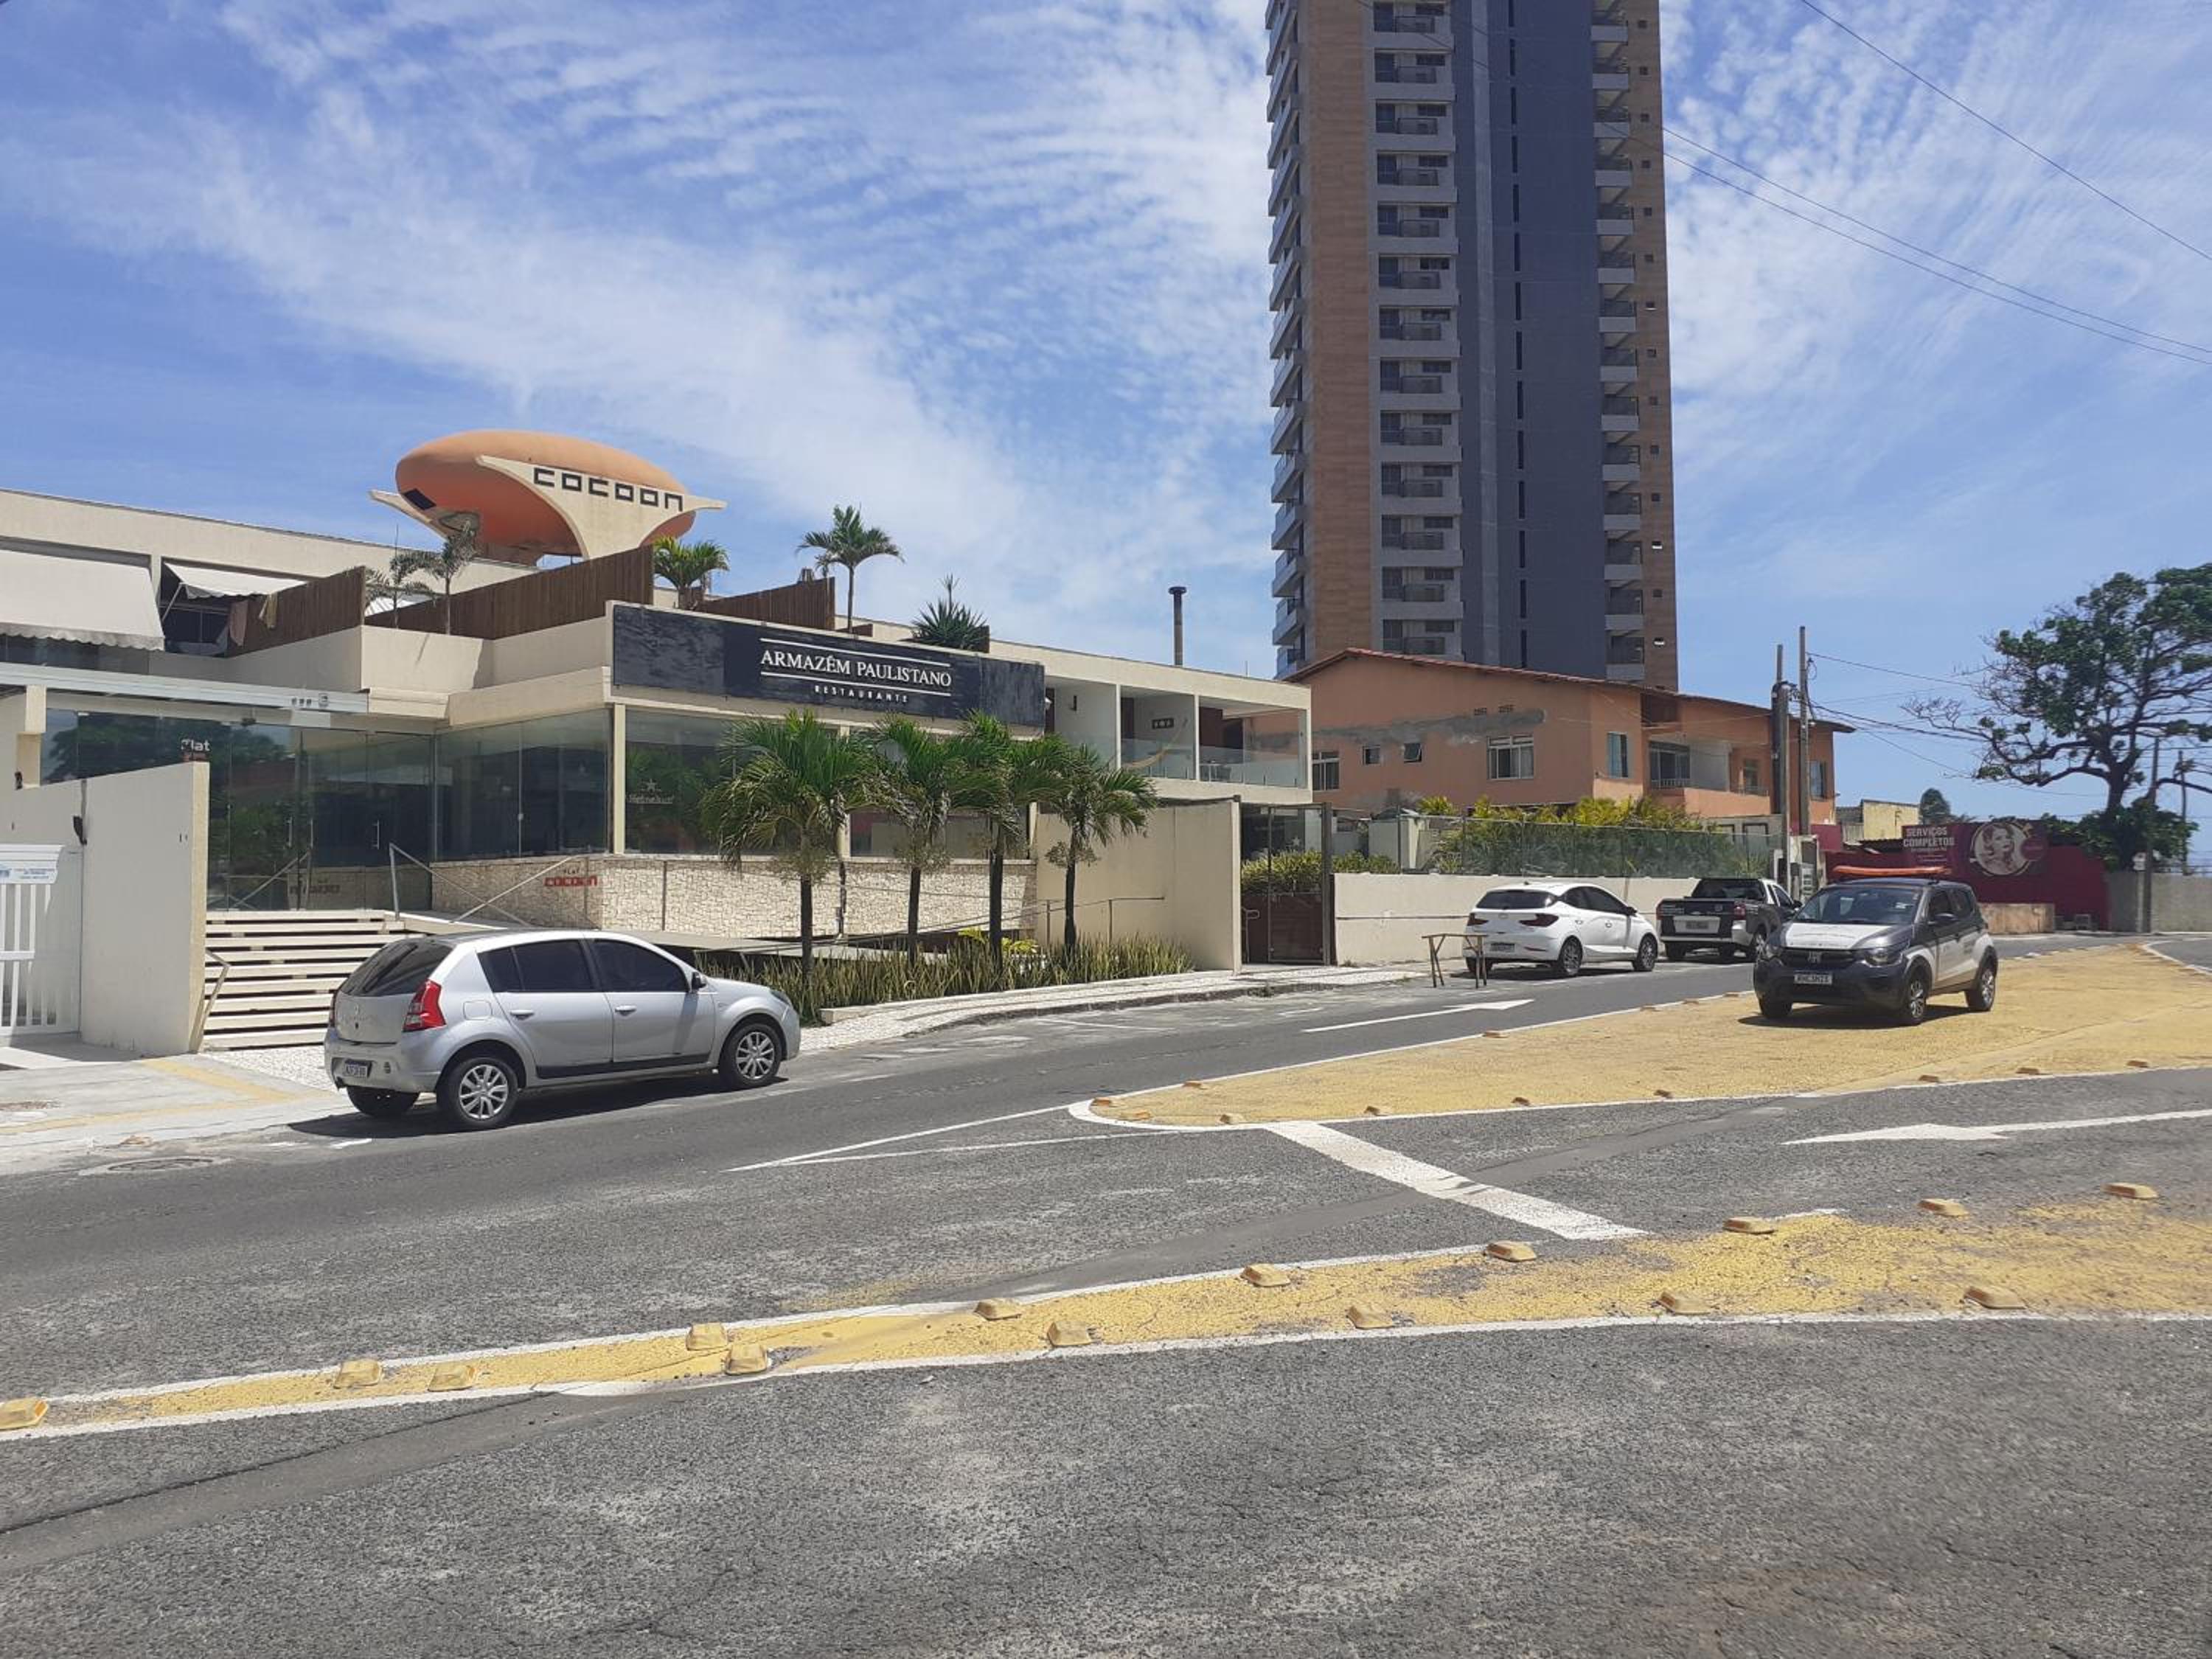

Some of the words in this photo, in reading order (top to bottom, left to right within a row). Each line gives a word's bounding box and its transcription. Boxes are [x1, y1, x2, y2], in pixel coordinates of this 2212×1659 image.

[761, 650, 851, 675] ARMAZÉM
[857, 661, 952, 687] PAULISTANO
[814, 684, 908, 703] RESTAURANTE
